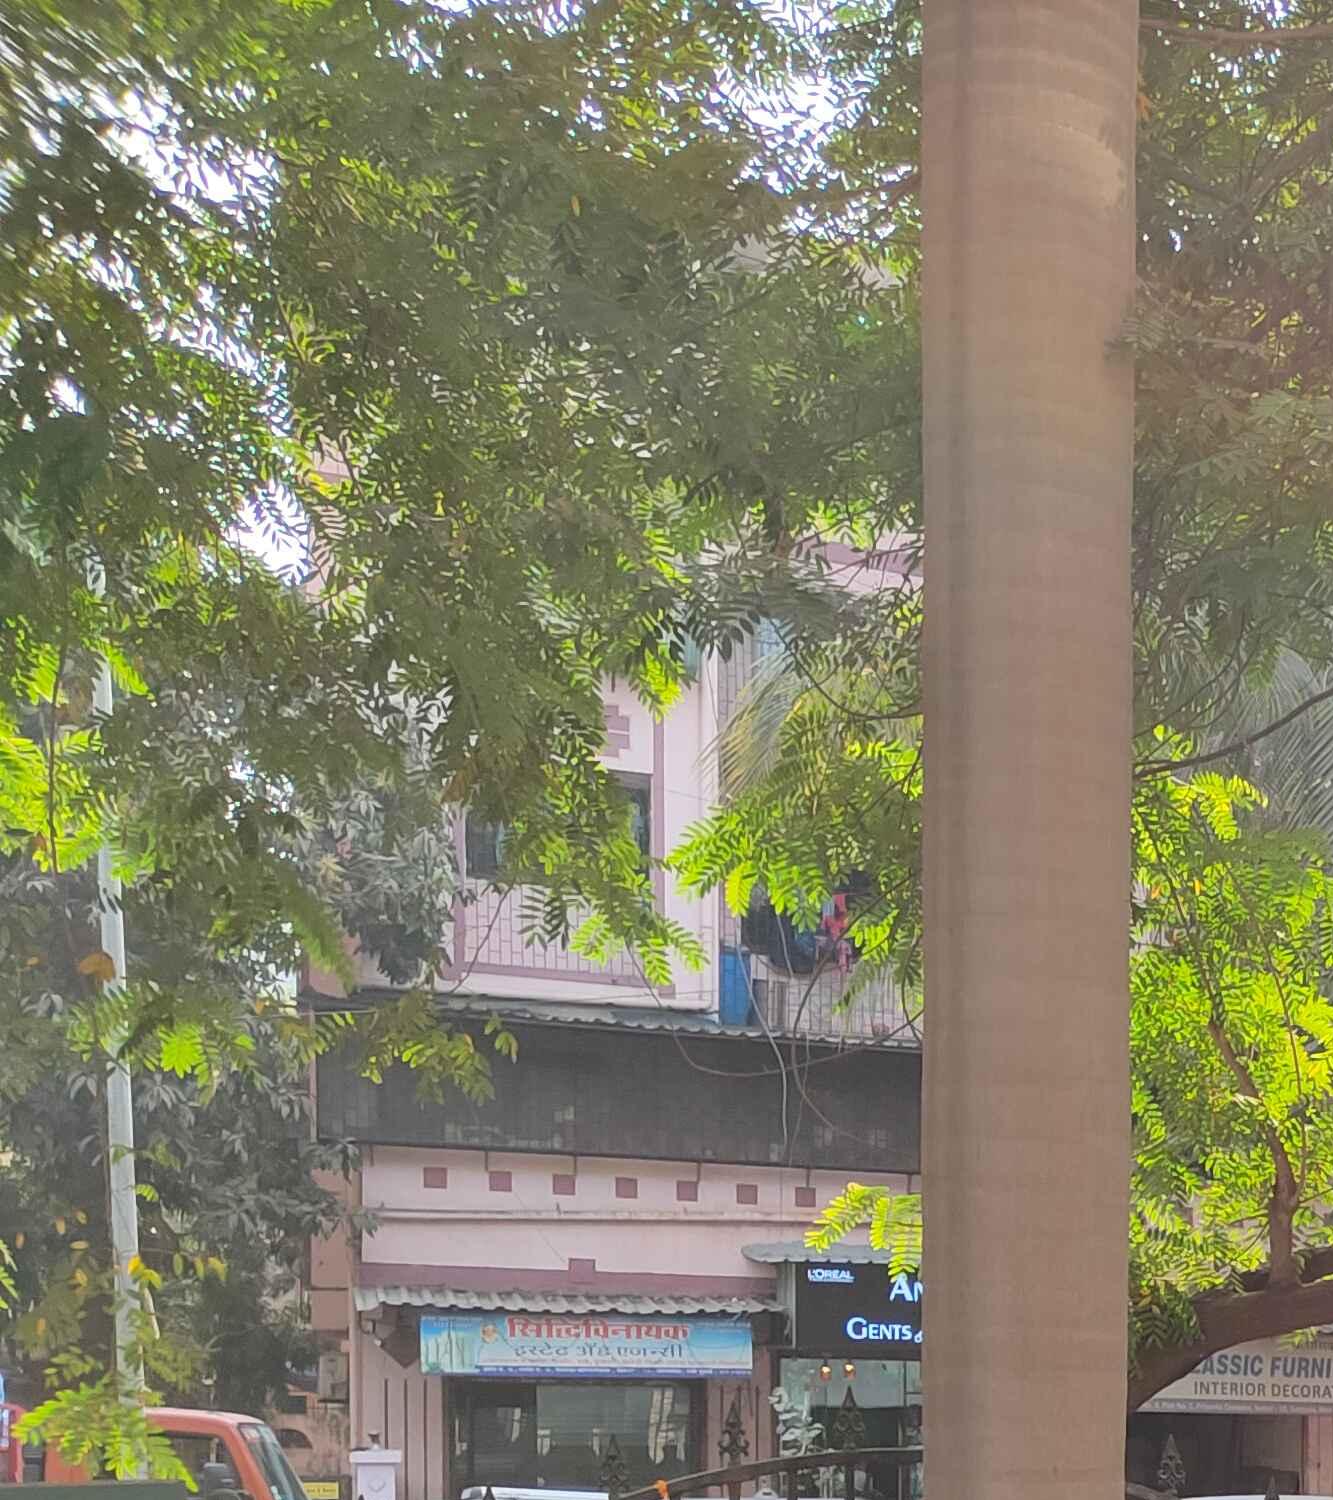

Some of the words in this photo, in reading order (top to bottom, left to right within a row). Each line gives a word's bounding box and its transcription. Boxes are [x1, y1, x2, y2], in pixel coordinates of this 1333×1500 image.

[846, 1316, 912, 1341] GENTS
[1194, 1353, 1265, 1376] ASSIC
[1194, 1381, 1265, 1397] INTERIOR
